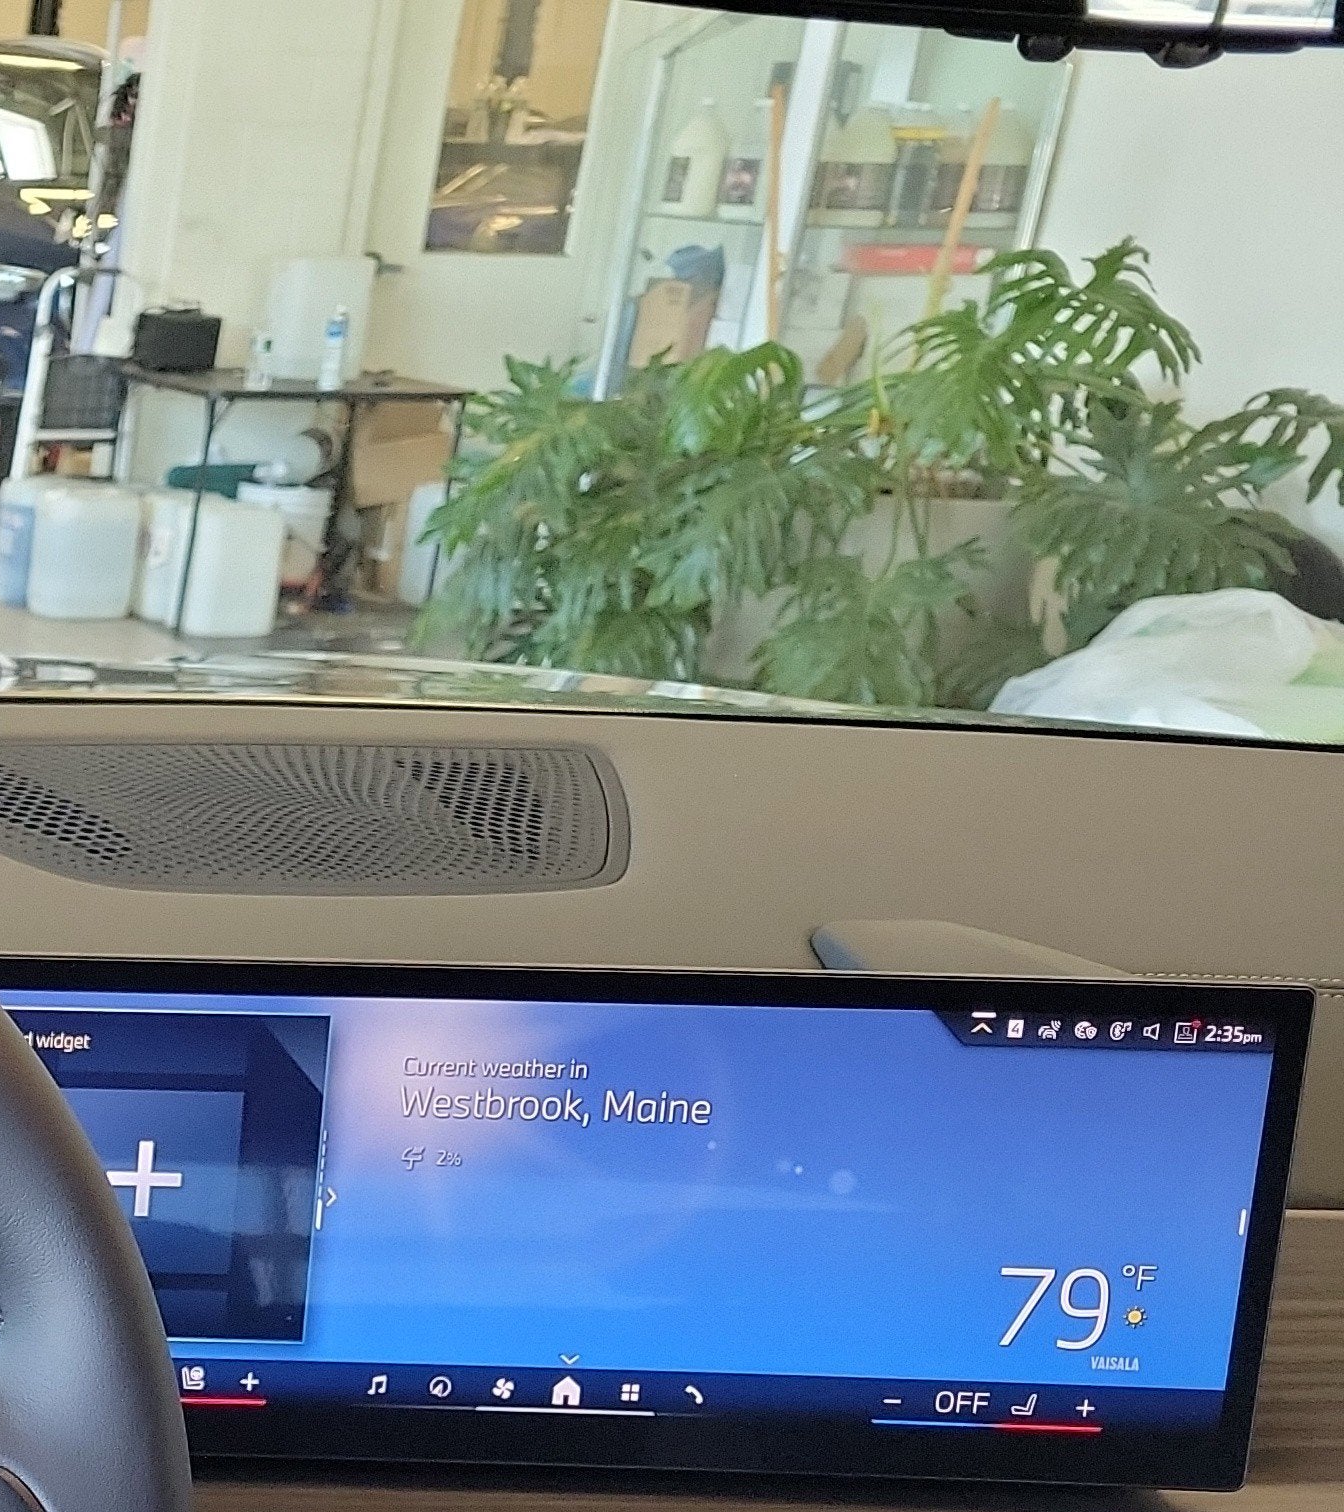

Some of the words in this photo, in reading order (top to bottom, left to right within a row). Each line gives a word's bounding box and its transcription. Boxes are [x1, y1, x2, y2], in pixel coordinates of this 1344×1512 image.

[36, 1032, 91, 1052] widget
[1205, 1025, 1263, 1044] 2:35pm
[403, 1056, 475, 1077] Current
[482, 1058, 566, 1080] weather
[569, 1058, 588, 1080] in
[400, 1086, 590, 1127] Westbrook,
[603, 1090, 712, 1124] Maine
[436, 1150, 462, 1166] 2%
[999, 1267, 1110, 1350] 79
[1122, 1264, 1159, 1291] °F
[1091, 1356, 1140, 1371] VAISALA
[935, 1391, 991, 1414] OFF
